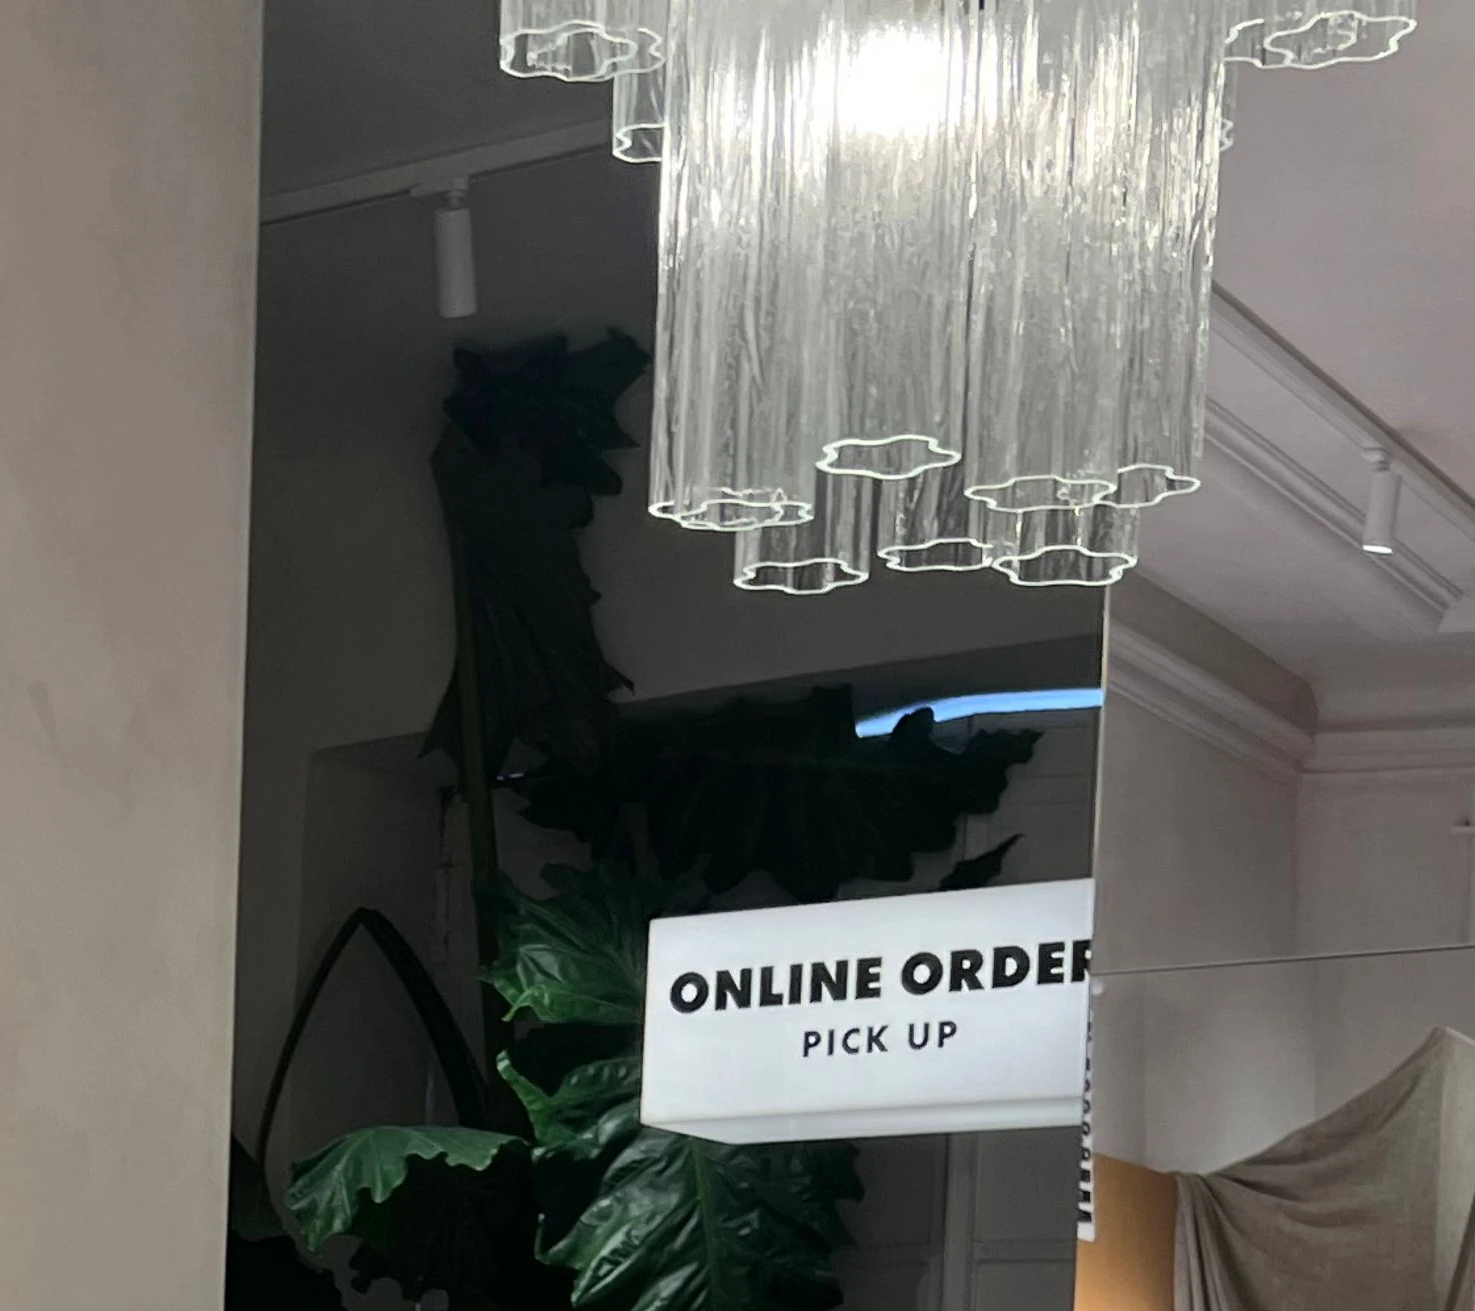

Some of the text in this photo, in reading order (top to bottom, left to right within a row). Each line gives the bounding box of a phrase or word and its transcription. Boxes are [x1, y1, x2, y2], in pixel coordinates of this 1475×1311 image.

[670, 957, 883, 1014] ONLINE
[802, 1021, 957, 1058] PICK UP
